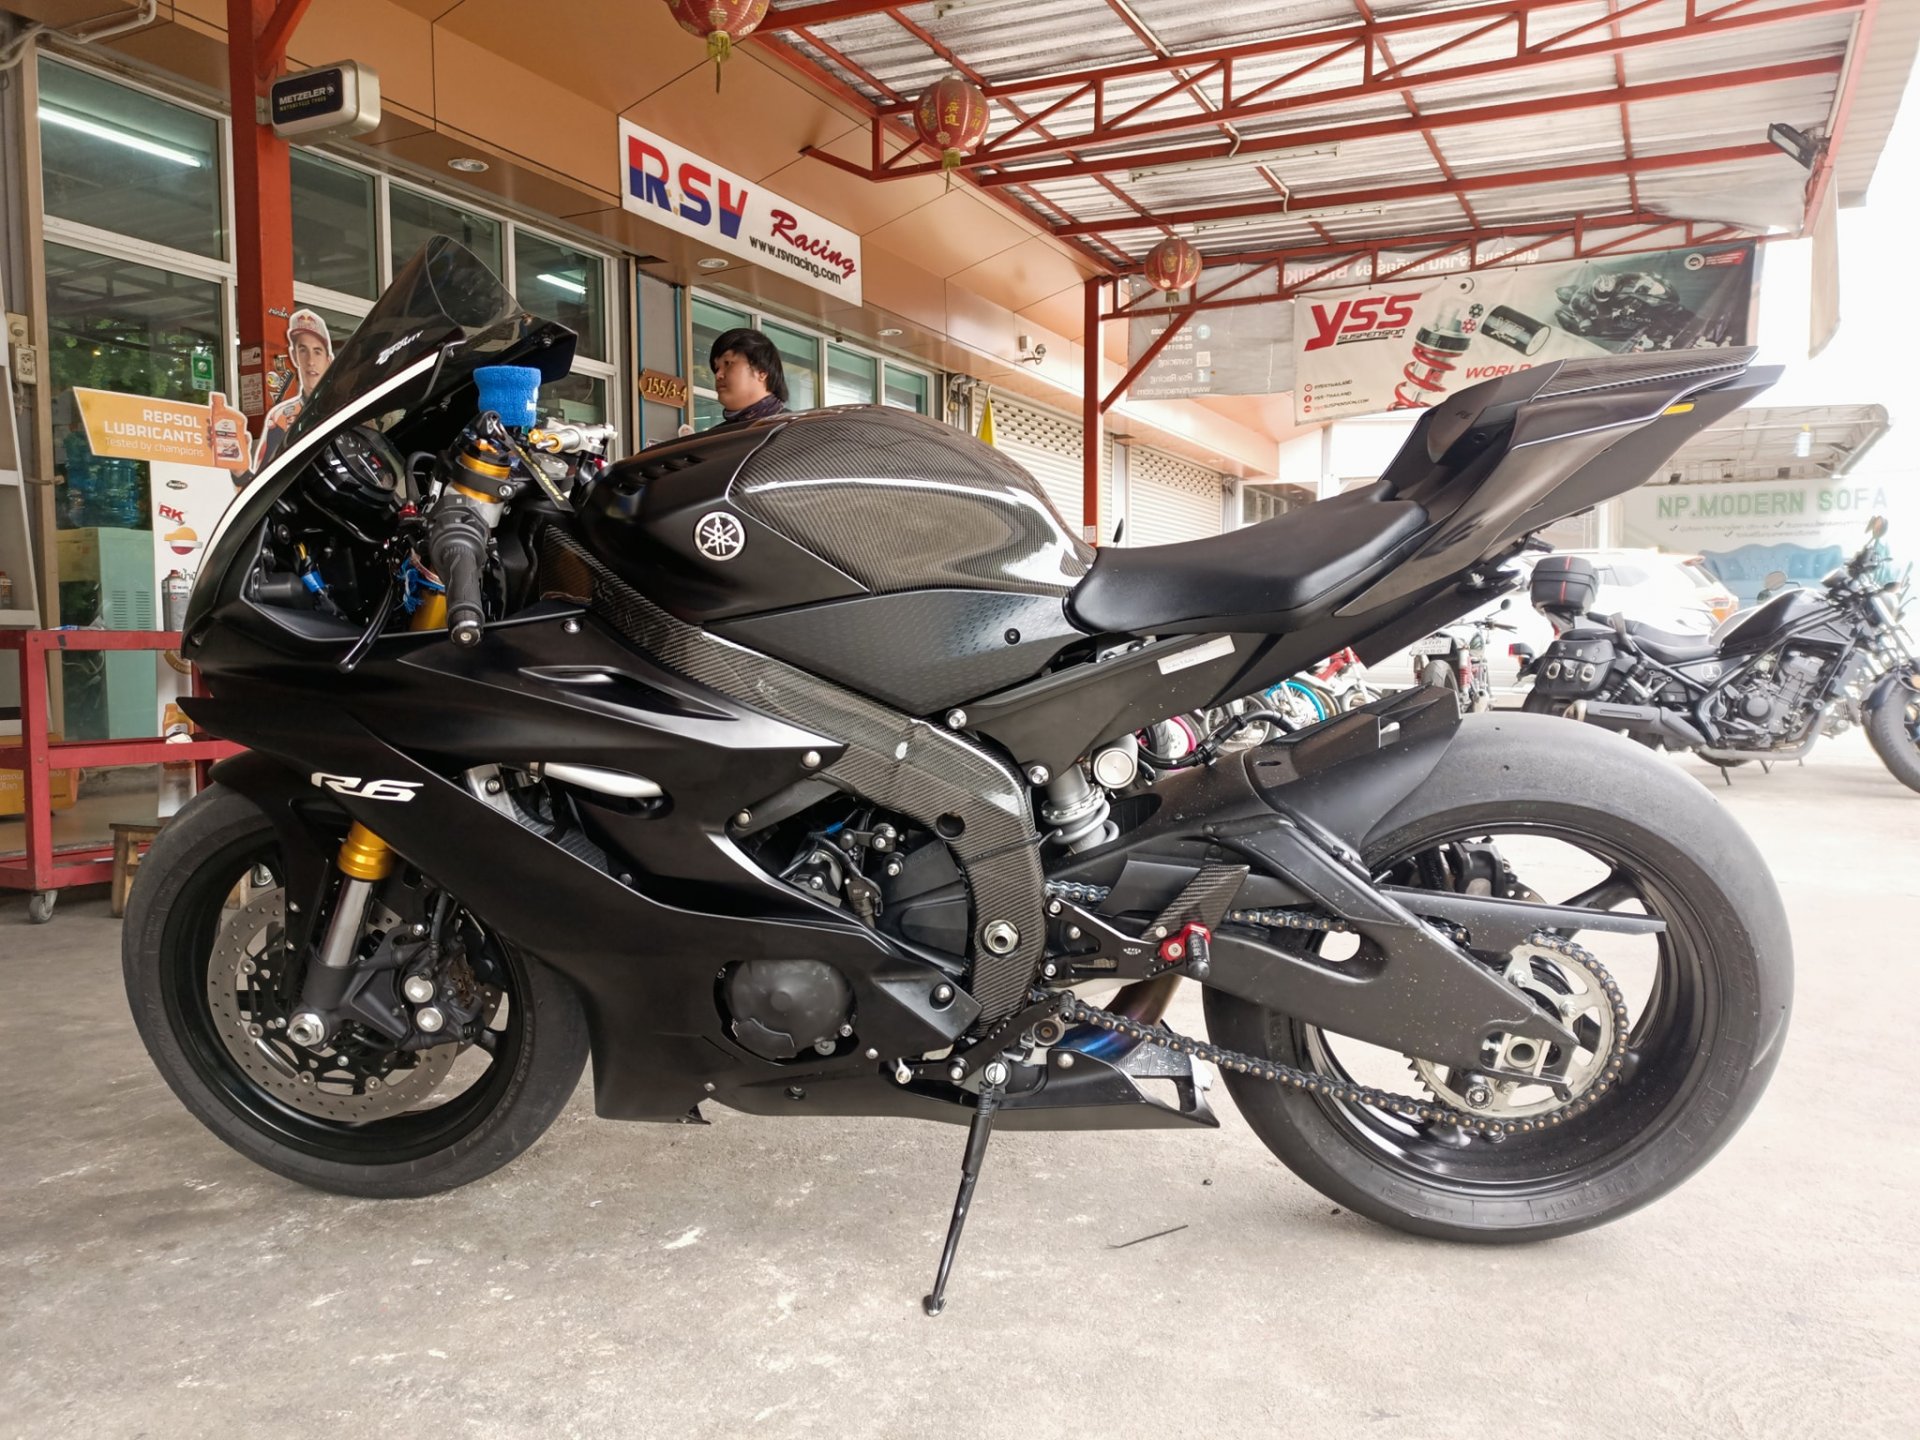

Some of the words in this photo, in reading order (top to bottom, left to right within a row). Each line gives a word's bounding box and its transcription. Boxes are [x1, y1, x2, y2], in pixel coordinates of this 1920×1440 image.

[279, 87, 326, 105] METZELER
[628, 134, 749, 240] RSV
[770, 209, 857, 280] Racing
[749, 235, 842, 285] www.rsvracing.com
[1304, 292, 1423, 351] YSS
[645, 377, 687, 401] 155/3-4
[104, 420, 203, 445] LUBRICANTS
[143, 409, 202, 429] REPSOL
[105, 437, 140, 449] Tested
[141, 440, 152, 453] by
[154, 444, 204, 457] champions
[159, 504, 184, 523] RK
[1658, 490, 1805, 518] NP.MODERN
[1818, 486, 1888, 512] SOFA
[311, 771, 424, 802] R6
